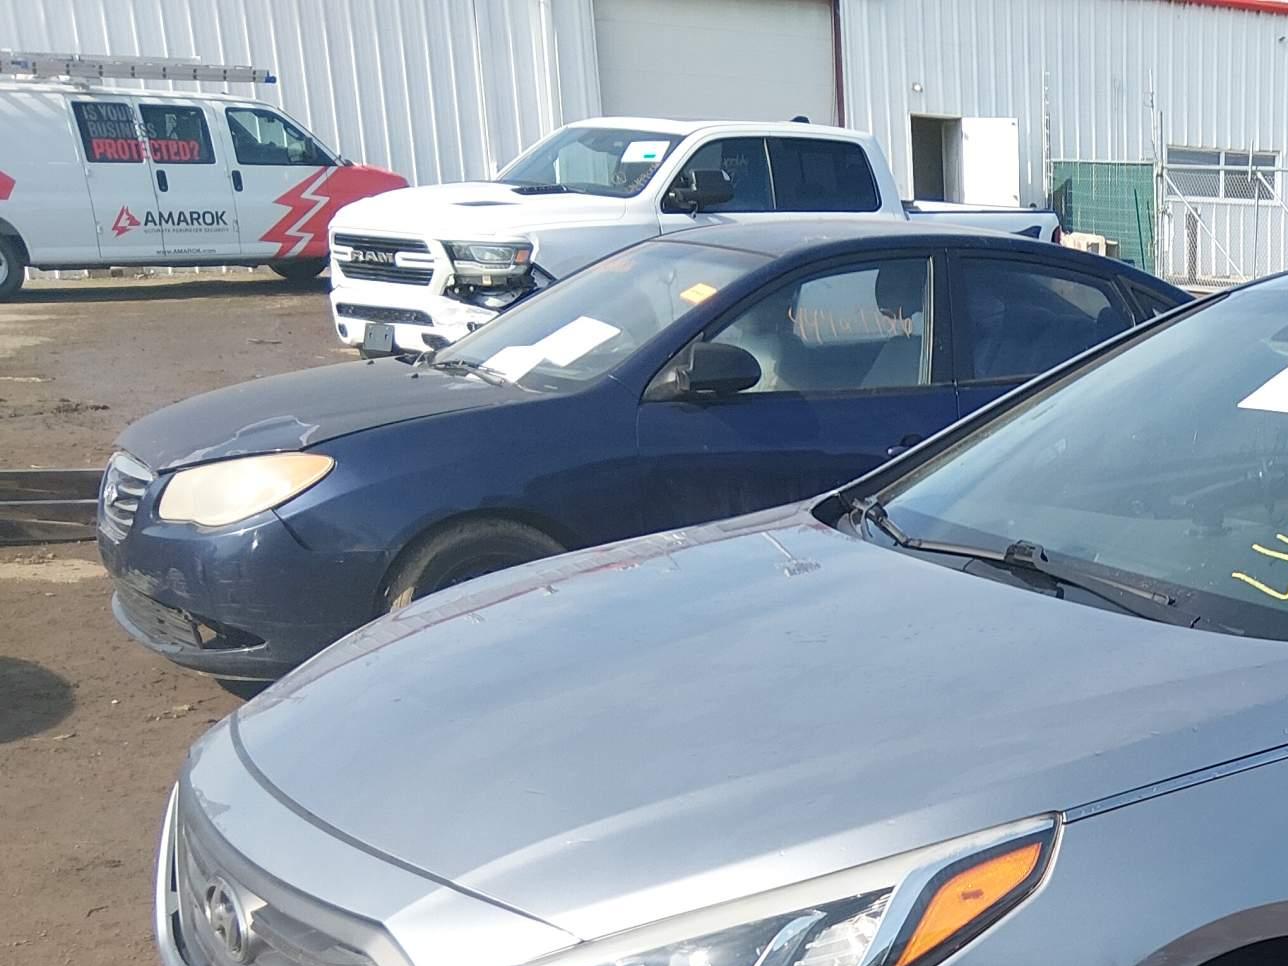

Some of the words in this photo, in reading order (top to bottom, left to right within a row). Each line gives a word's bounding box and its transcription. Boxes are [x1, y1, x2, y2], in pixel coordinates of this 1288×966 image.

[82, 104, 97, 120] IS
[99, 104, 136, 121] YOUR
[87, 121, 157, 138] BUSINESS
[91, 138, 200, 161] PROTECTED?
[144, 210, 228, 226] AMAROK
[350, 249, 394, 264] RAM
